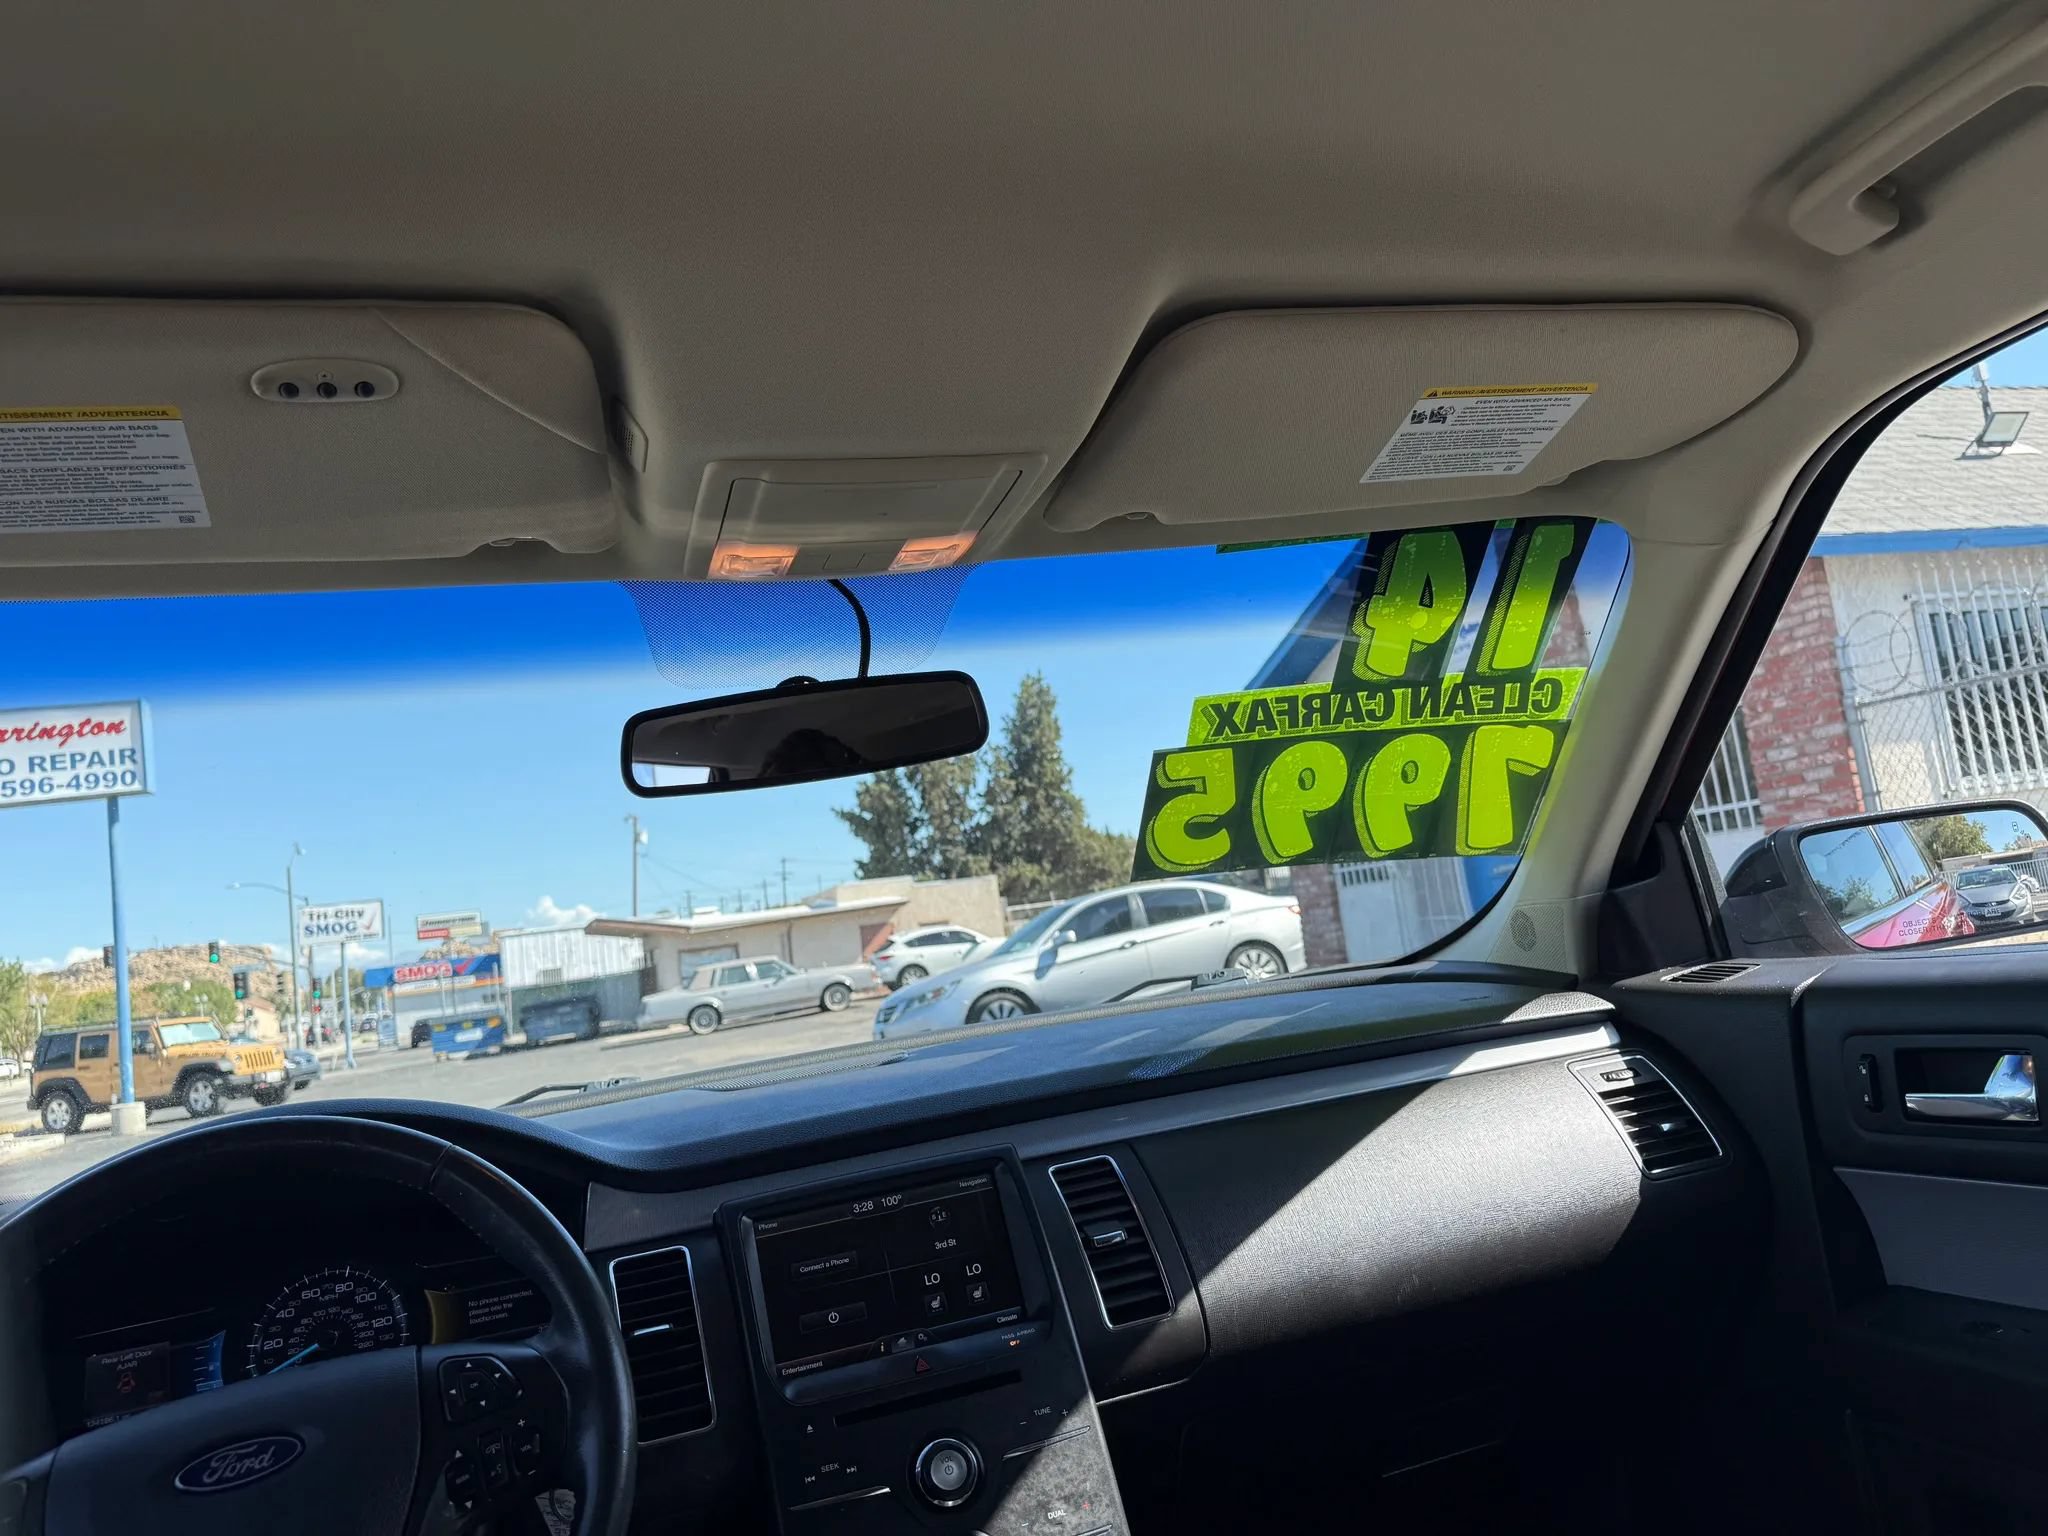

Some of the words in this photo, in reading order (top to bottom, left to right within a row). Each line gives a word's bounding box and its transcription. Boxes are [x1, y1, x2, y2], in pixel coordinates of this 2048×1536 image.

[0, 411, 73, 419] TISSEMENT
[28, 747, 138, 774] REPAIR
[1, 769, 137, 797] 596-4990
[304, 921, 358, 936] SMOG
[1898, 926, 1929, 937] CLOSER
[396, 963, 451, 982] SMOG
[958, 1176, 988, 1188] Navigation
[852, 1200, 874, 1213] 3:28
[758, 1221, 778, 1231] Phone
[934, 1240, 948, 1250] 3rd
[947, 1238, 957, 1248] St
[799, 1261, 825, 1274] Connect
[830, 1257, 850, 1269] Phone
[966, 1263, 982, 1277] LO
[924, 1273, 941, 1286] LO
[335, 1281, 354, 1293] 80
[301, 1288, 321, 1300] 60
[354, 1291, 377, 1304] 100
[275, 1308, 295, 1319] 40
[997, 1313, 1018, 1324] Climate
[371, 1316, 393, 1328] 120
[263, 1338, 284, 1350] 20
[782, 1361, 823, 1376] Entertainment
[1034, 1406, 1051, 1417] TUNE
[203, 1444, 276, 1483] Ford
[940, 1455, 953, 1465] VOL
[820, 1462, 840, 1474] SEEK
[1047, 1508, 1066, 1520] DUAL
